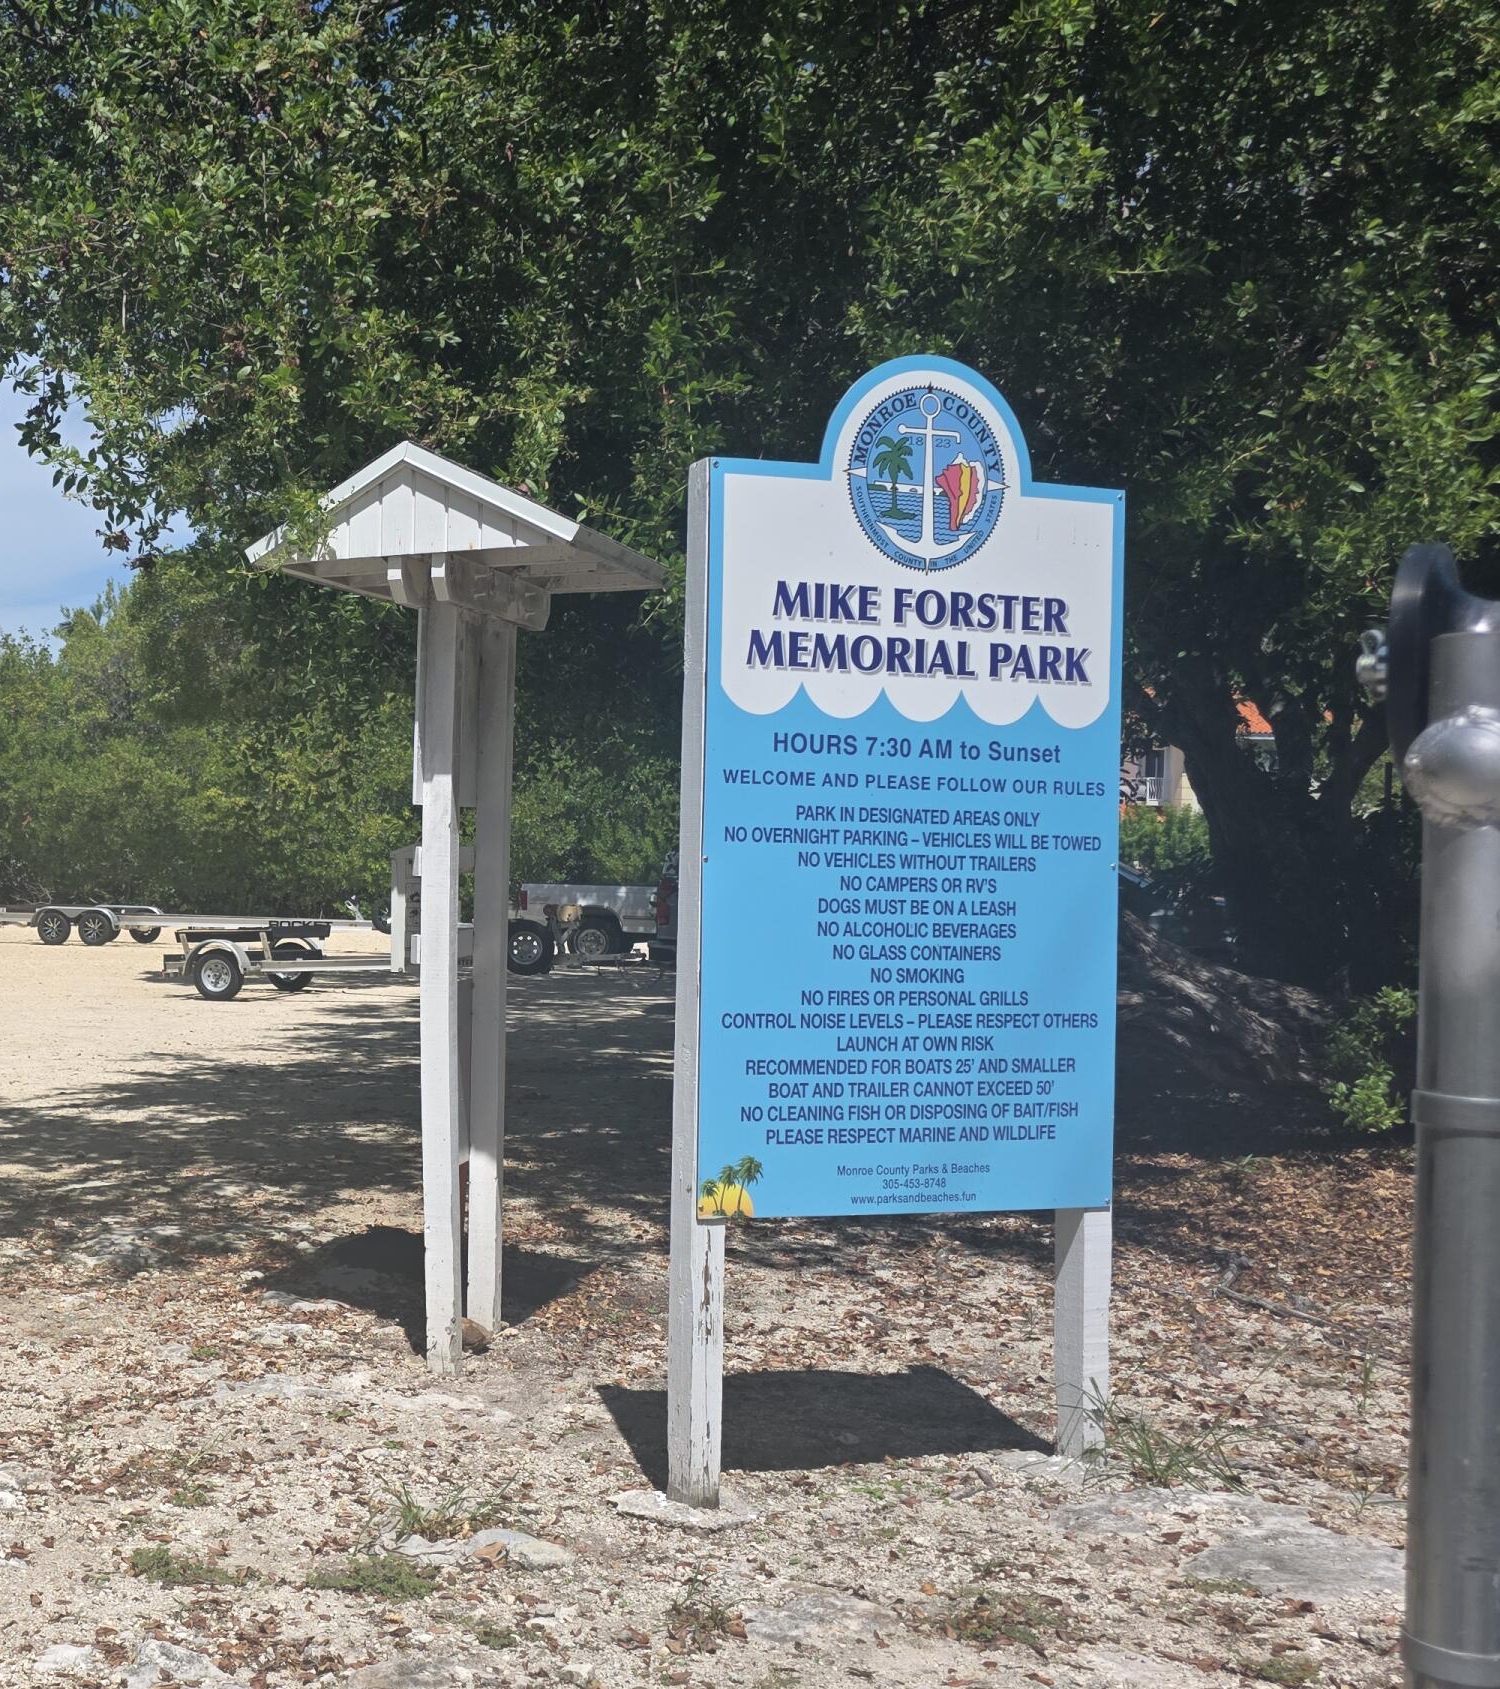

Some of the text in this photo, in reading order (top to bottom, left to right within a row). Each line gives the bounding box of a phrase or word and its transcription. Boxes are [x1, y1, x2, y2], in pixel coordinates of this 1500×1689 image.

[853, 392, 1000, 474] MONROE COUNTY
[909, 436, 951, 448] 18 23
[855, 485, 998, 568] SOUTHERNMOST COUNTY IN THE UNITED STATES
[772, 580, 1067, 633] MIKE FORSTER
[746, 628, 1089, 682] MEMORIAL PARK
[774, 732, 1060, 763] HOURS 7:30 AM to Sunset
[723, 769, 1105, 796] WELCOME AND PLEASE FOLLOW OUR RULES
[796, 805, 1040, 827] PARK IN DESIGNATED AREAS ONLY
[724, 826, 748, 842] NO
[752, 827, 840, 844] OVERNIGHT
[844, 830, 908, 846] PARKING
[922, 832, 991, 849] VEHICLES
[994, 834, 1028, 849] WILL
[1031, 834, 1049, 850] BE
[1052, 835, 1101, 851] TOWED
[798, 851, 1036, 872] NO VEHICLES WITHOUT TRAILERS
[840, 876, 862, 891] NO
[866, 876, 938, 893] CAMPERS
[941, 877, 962, 893] OR
[818, 898, 1016, 916] DOGS MUST BE ON A LEASH
[818, 921, 1016, 939] NO ALCOHOLIC BEVERAGES
[833, 944, 1001, 961] NO GLASS CONTAINERS
[870, 968, 964, 984] NO SMOKING
[801, 990, 1028, 1006] NO FIRES OR PERSONAL GRILLS
[722, 1013, 796, 1029] CONTROL
[800, 1013, 846, 1029] NOISE
[850, 1013, 904, 1029] LEVELS
[918, 1013, 972, 1029] PLEASE
[976, 1013, 1040, 1029] RESPECT
[1043, 1013, 1098, 1028] OTHERS
[837, 1036, 994, 1052] LAUNCH AT OWN RISK
[746, 1059, 868, 1075] RECOMMENDED
[872, 1059, 901, 1075] FOR
[905, 1058, 952, 1074] BOATS
[978, 1058, 1008, 1074] AND
[1011, 1058, 1076, 1074] SMALLER
[769, 1082, 809, 1098] BOAT
[812, 1082, 844, 1098] AND
[848, 1082, 909, 1098] TRAILER
[913, 1081, 974, 1097] CANNOT
[978, 1080, 1033, 1096] EXCEED
[741, 1102, 1078, 1122] NO CLEANING FISH OR DISPOSING OF BAIT/FISH
[766, 1124, 1056, 1145] PLEASE RESPECT MARINE AND WILDLIFE
[837, 1163, 990, 1178] Monroe County Parks & Beaches
[882, 1177, 946, 1190] 305-453-8748
[851, 1191, 976, 1206] www.parksandbeaches.fun
